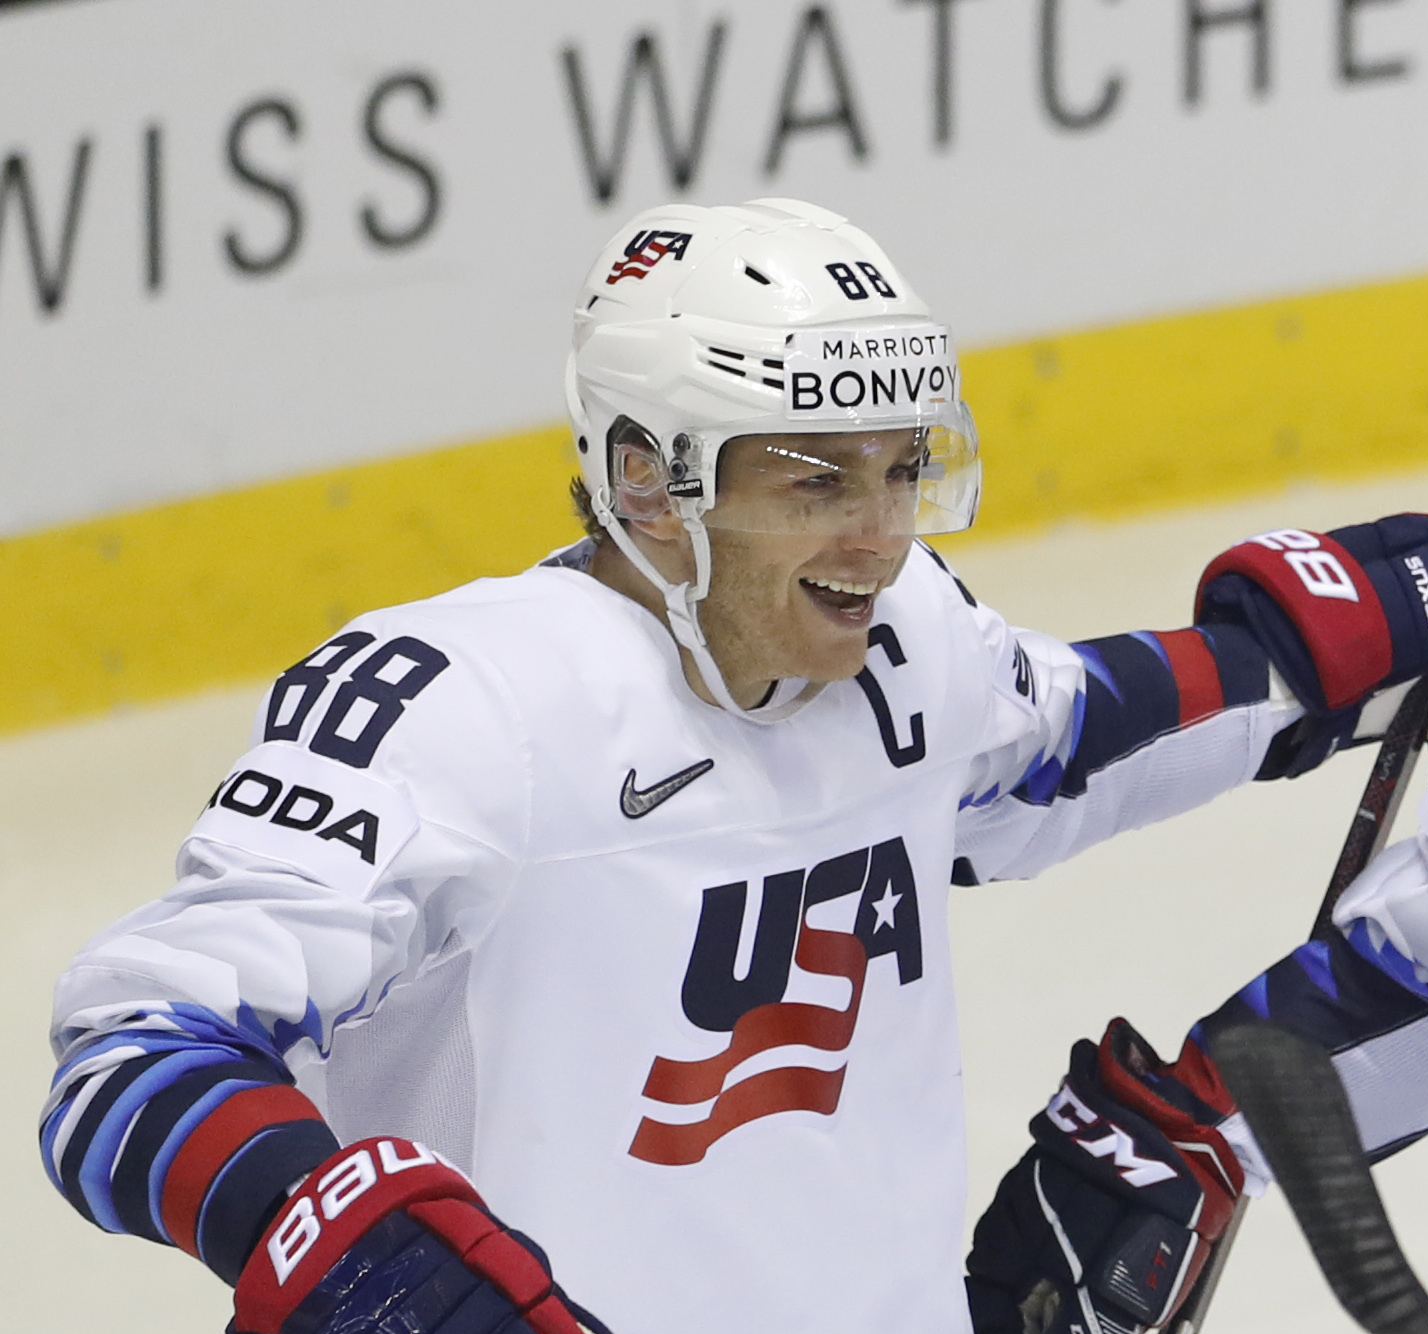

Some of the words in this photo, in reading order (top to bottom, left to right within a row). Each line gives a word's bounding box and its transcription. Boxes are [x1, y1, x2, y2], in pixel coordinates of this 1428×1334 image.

[825, 261, 897, 301] 88
[792, 363, 957, 411] BONVOY
[823, 334, 948, 360] MARRIOTT
[263, 630, 451, 769] 88
[855, 623, 926, 768] C
[672, 836, 923, 1065] USA
